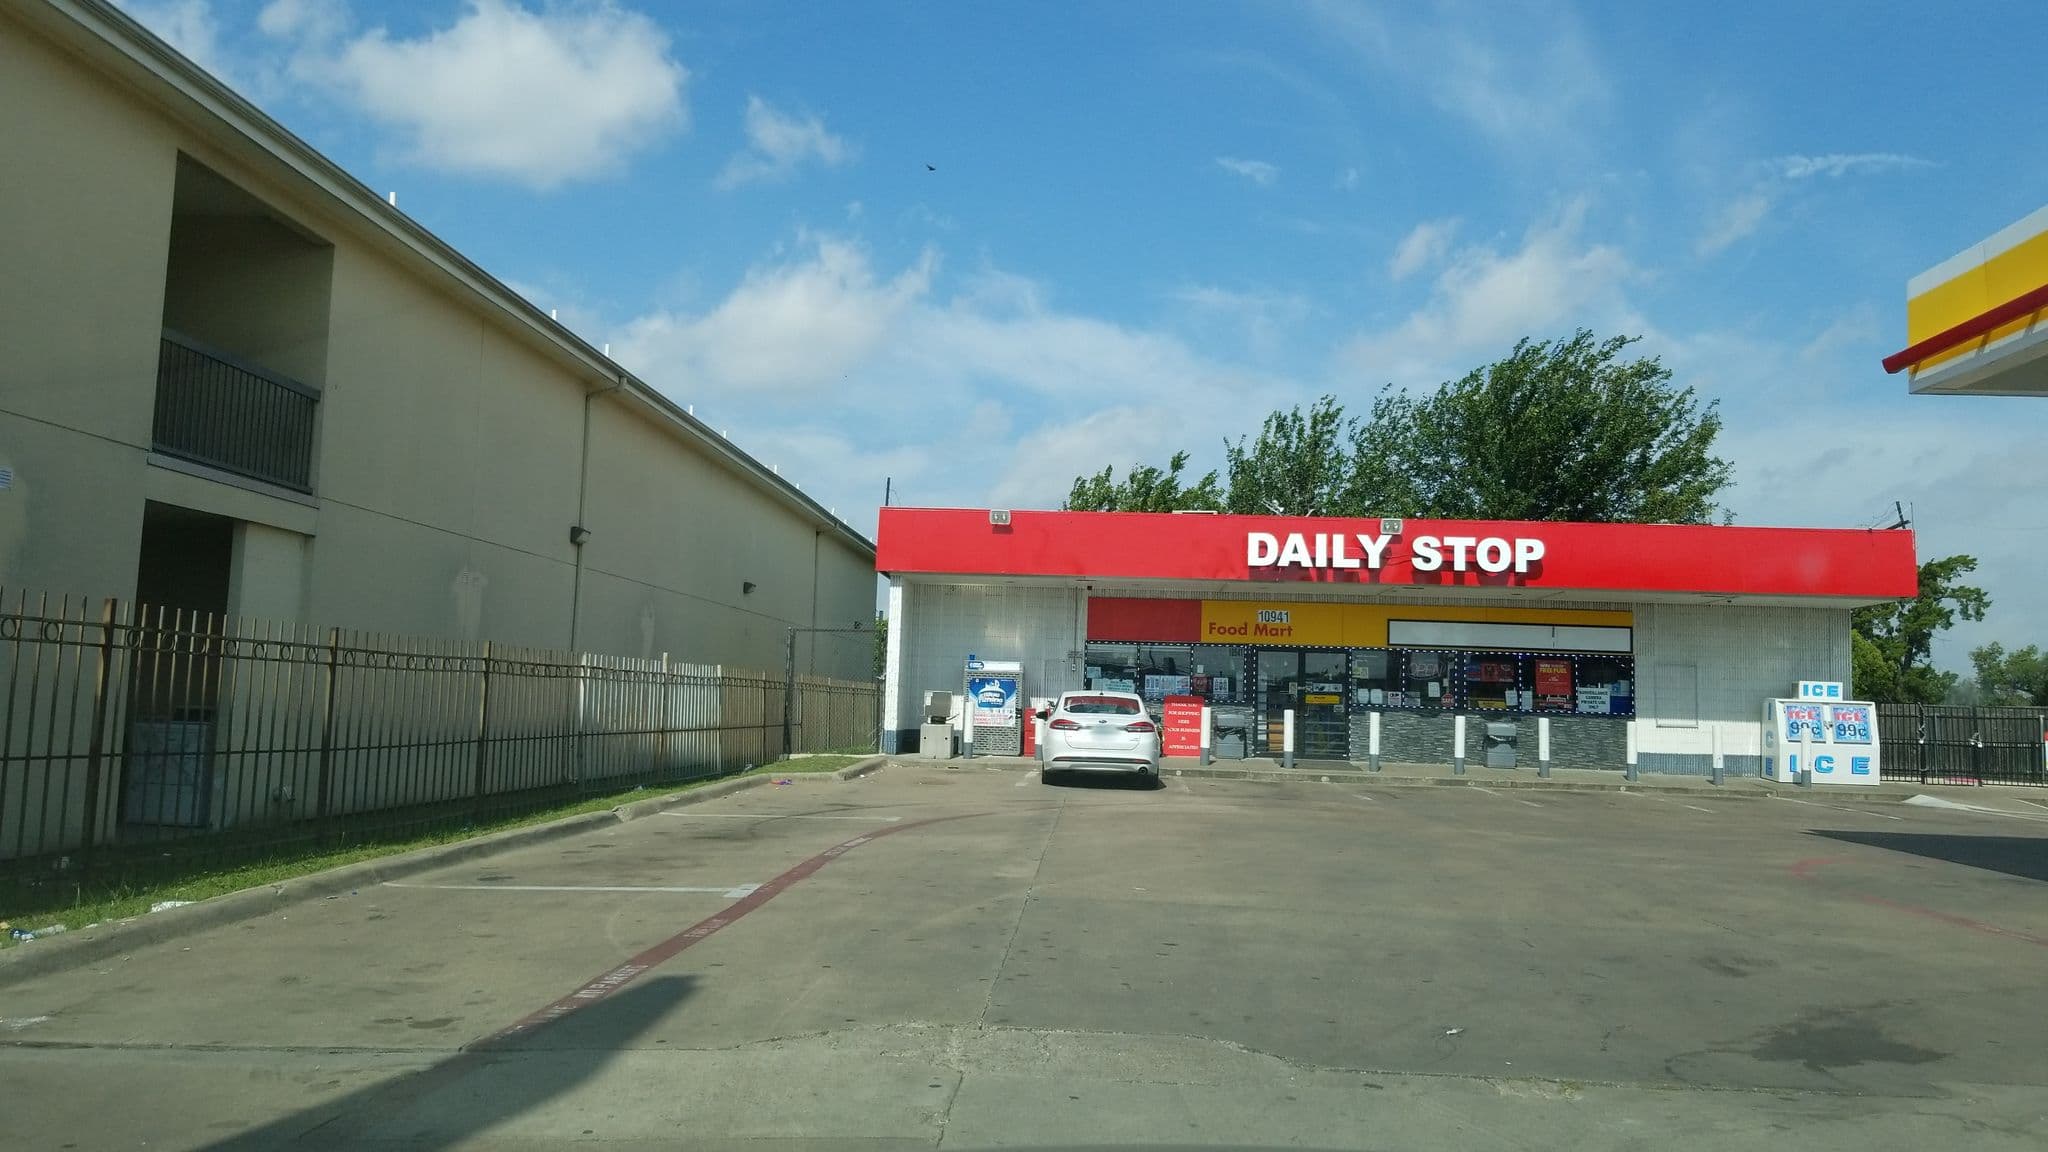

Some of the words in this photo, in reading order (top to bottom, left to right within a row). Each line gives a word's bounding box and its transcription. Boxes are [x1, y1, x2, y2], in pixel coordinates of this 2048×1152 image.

[1247, 532, 1392, 569] DAILY
[1411, 535, 1545, 573] STOP
[1258, 610, 1290, 624] 10941
[1208, 622, 1248, 636] Food
[1253, 623, 1294, 637] Mart
[1802, 683, 1839, 697] ICE
[1787, 709, 1816, 720] ICE
[1833, 711, 1863, 722] ICE
[1789, 754, 1871, 776] ICE
